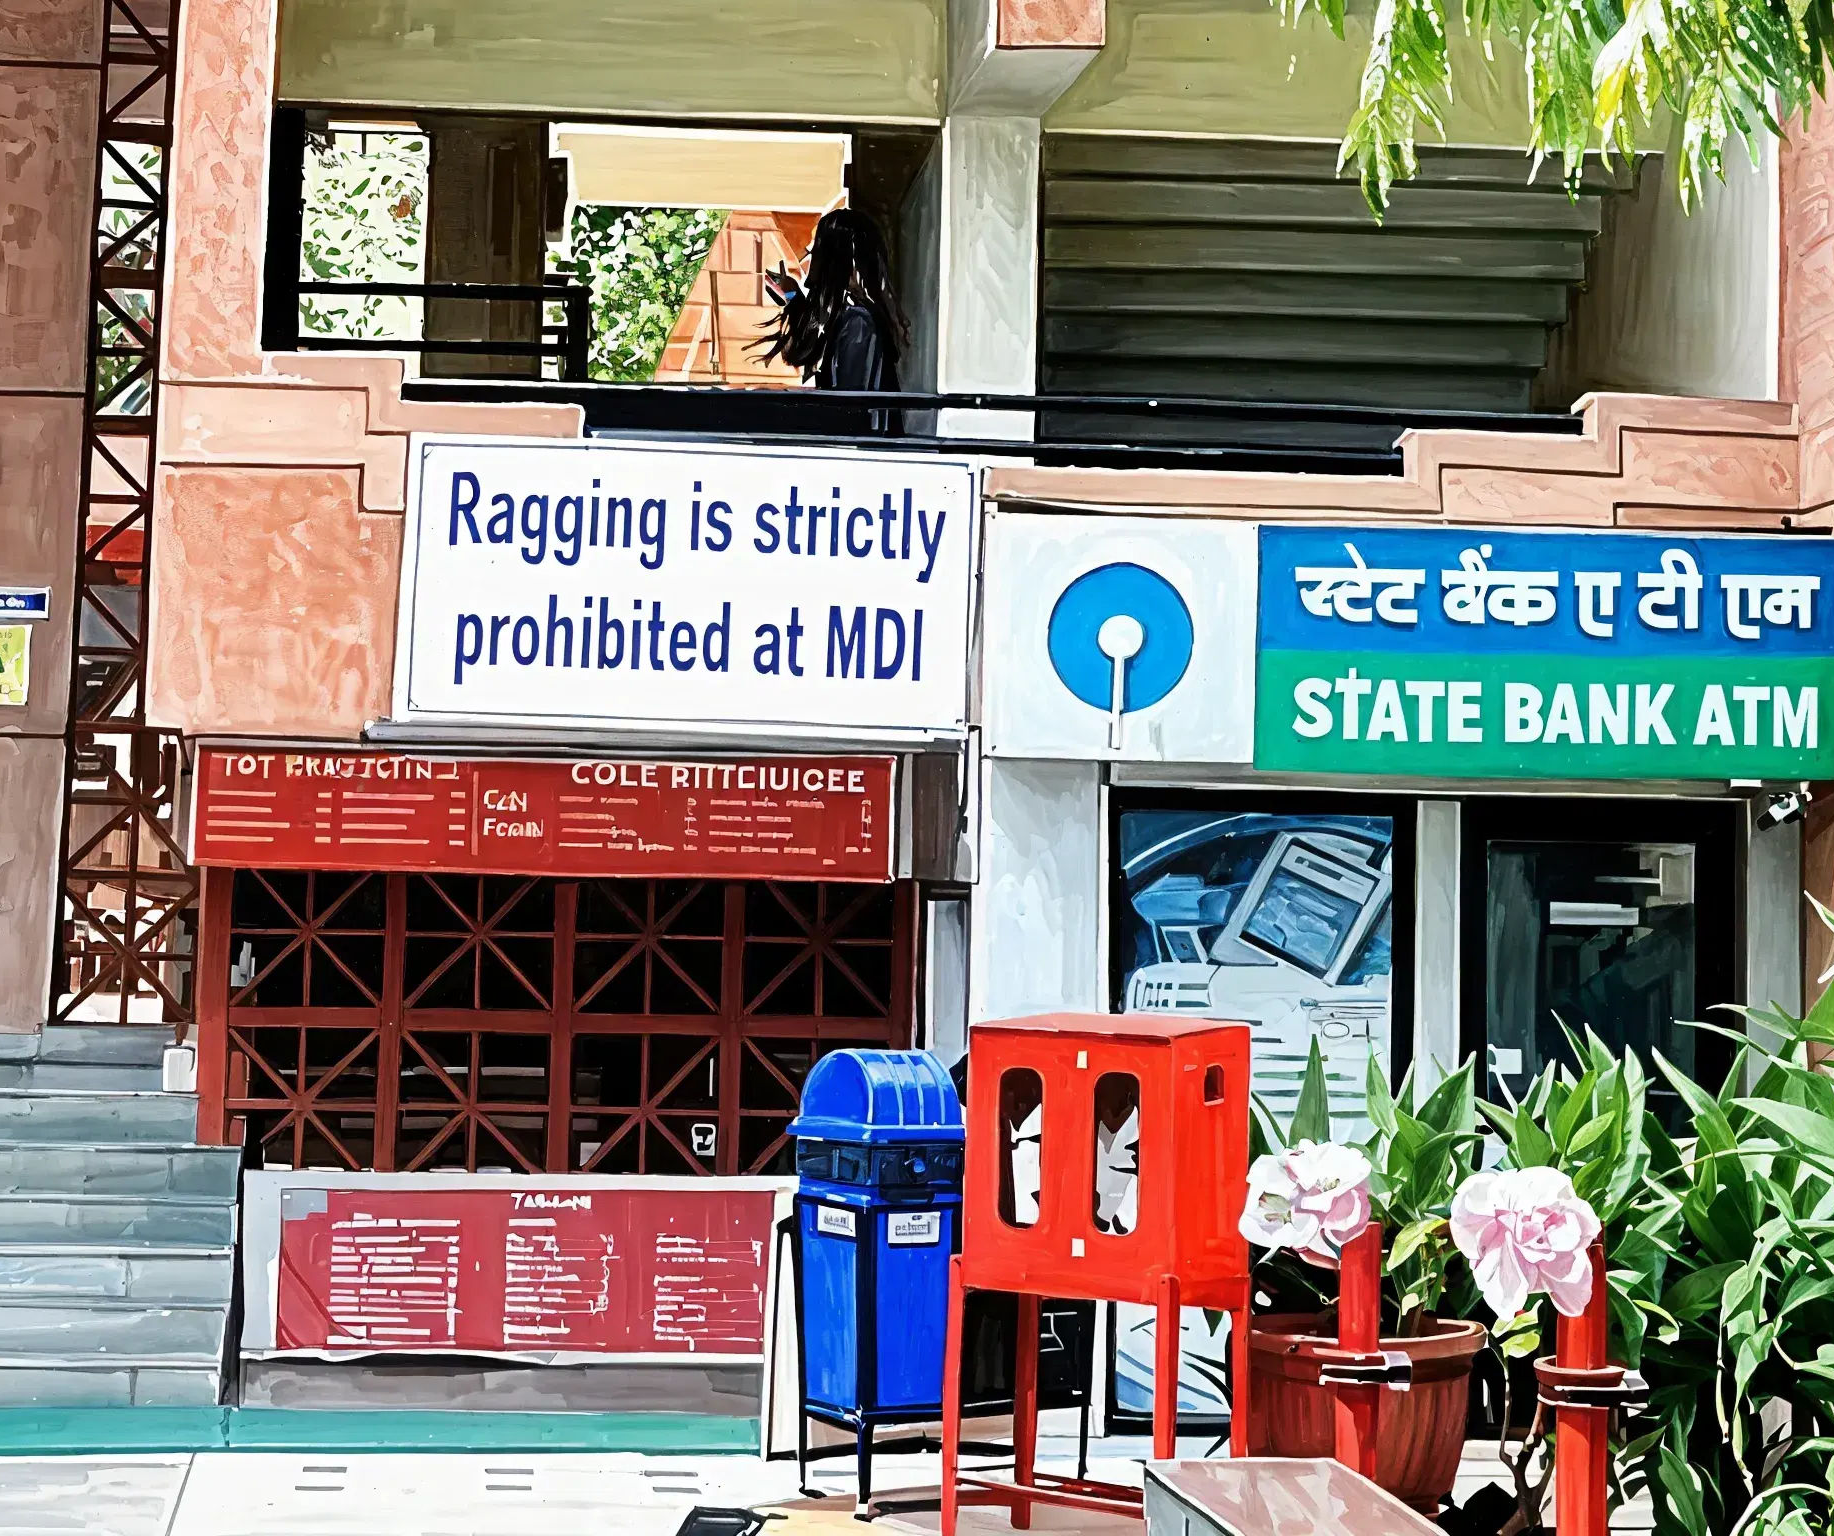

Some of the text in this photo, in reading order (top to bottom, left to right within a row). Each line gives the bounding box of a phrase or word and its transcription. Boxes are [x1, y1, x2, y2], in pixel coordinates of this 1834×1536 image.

[449, 471, 946, 583] Ragging is strictly
[1574, 571, 1622, 637] ए
[1638, 548, 1703, 629] टी
[1721, 574, 1821, 639] एम
[454, 594, 924, 684] prohibited at MDI
[1292, 667, 1819, 749] STATE BANK ATM
